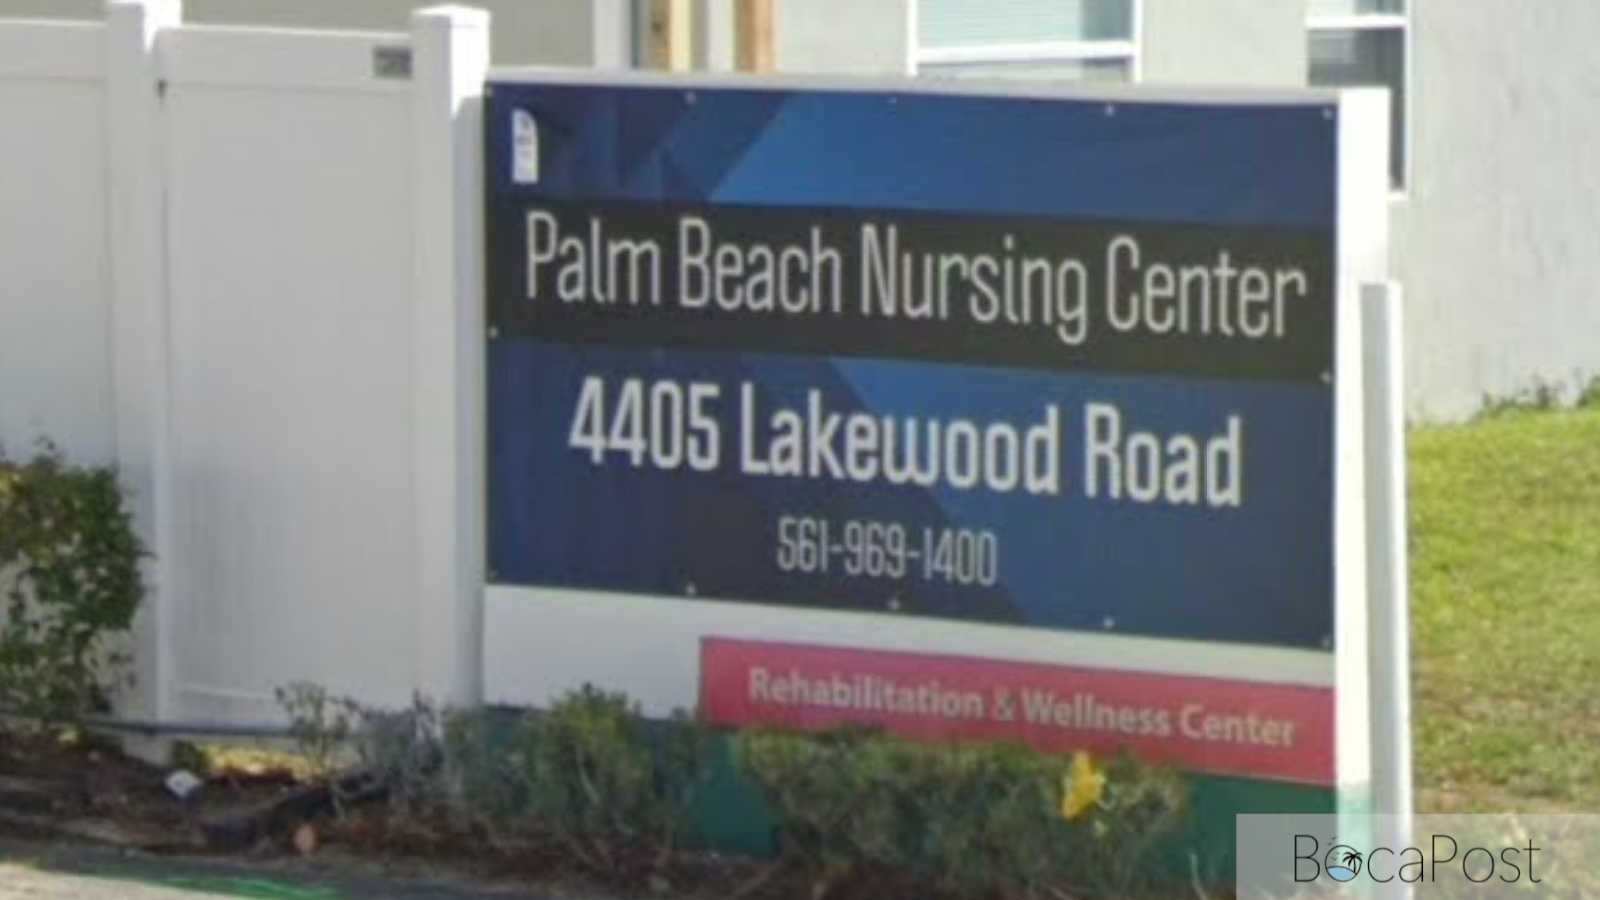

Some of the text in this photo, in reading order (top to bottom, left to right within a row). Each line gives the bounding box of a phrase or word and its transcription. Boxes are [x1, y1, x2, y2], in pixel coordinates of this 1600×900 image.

[526, 211, 1306, 345] Palm Beach Nursing Center
[569, 376, 1241, 507] 4405 Lakewood Road
[777, 517, 997, 587] 561-969-1400
[749, 667, 1296, 748] Rehabilitation & Wellness Center
